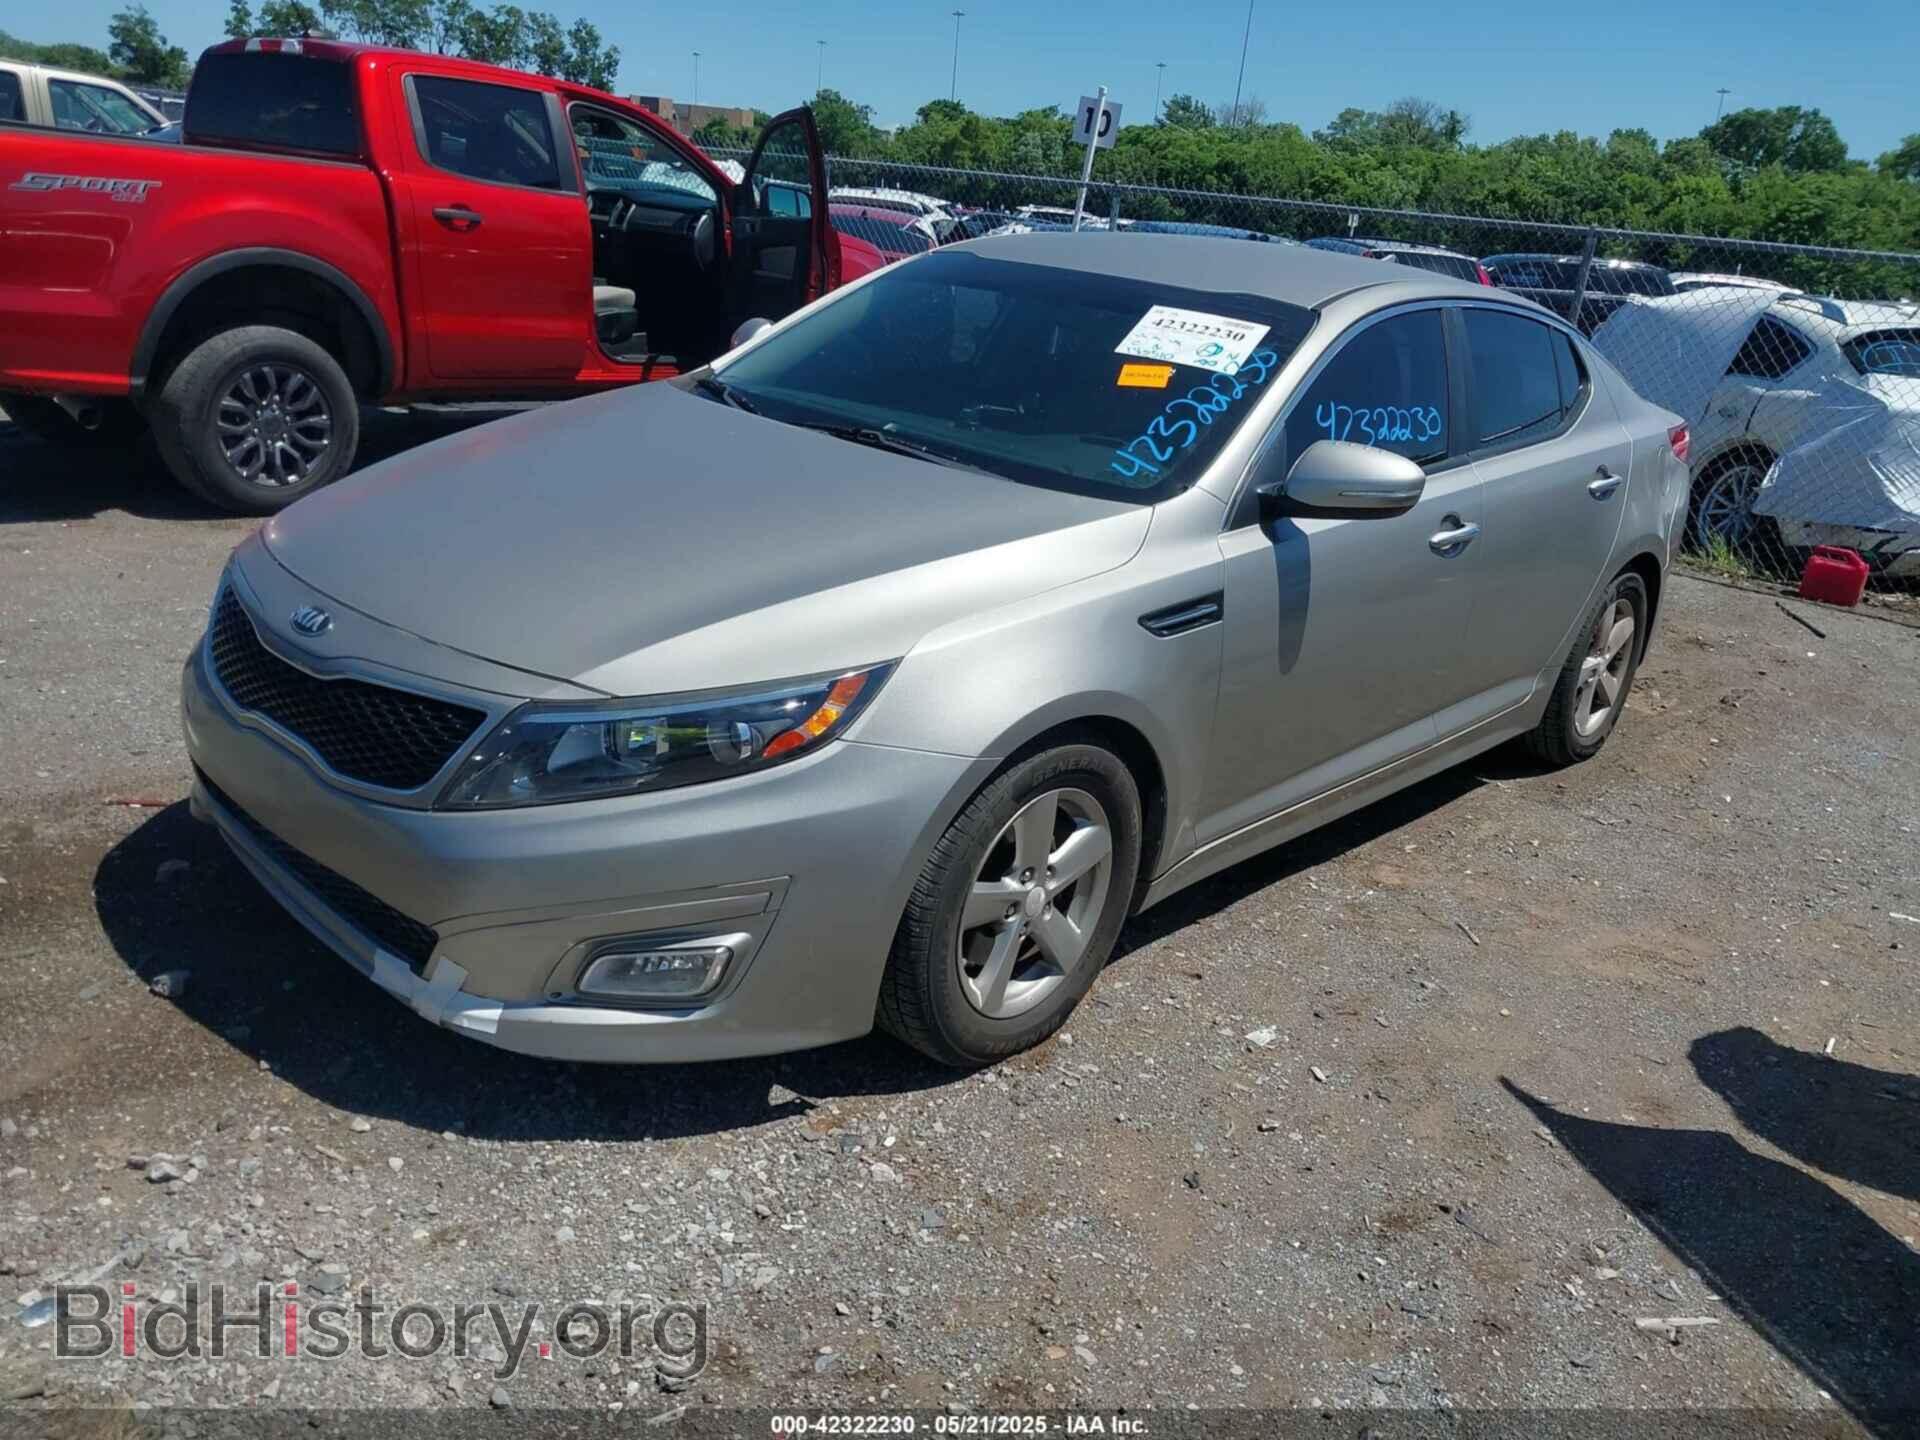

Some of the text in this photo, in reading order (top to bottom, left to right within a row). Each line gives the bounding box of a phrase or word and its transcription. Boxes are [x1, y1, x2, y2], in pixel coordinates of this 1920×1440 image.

[1084, 106, 1112, 138] 10
[8, 172, 163, 193] SPORT
[1152, 318, 1246, 342] 42322230
[297, 607, 326, 632] KIA
